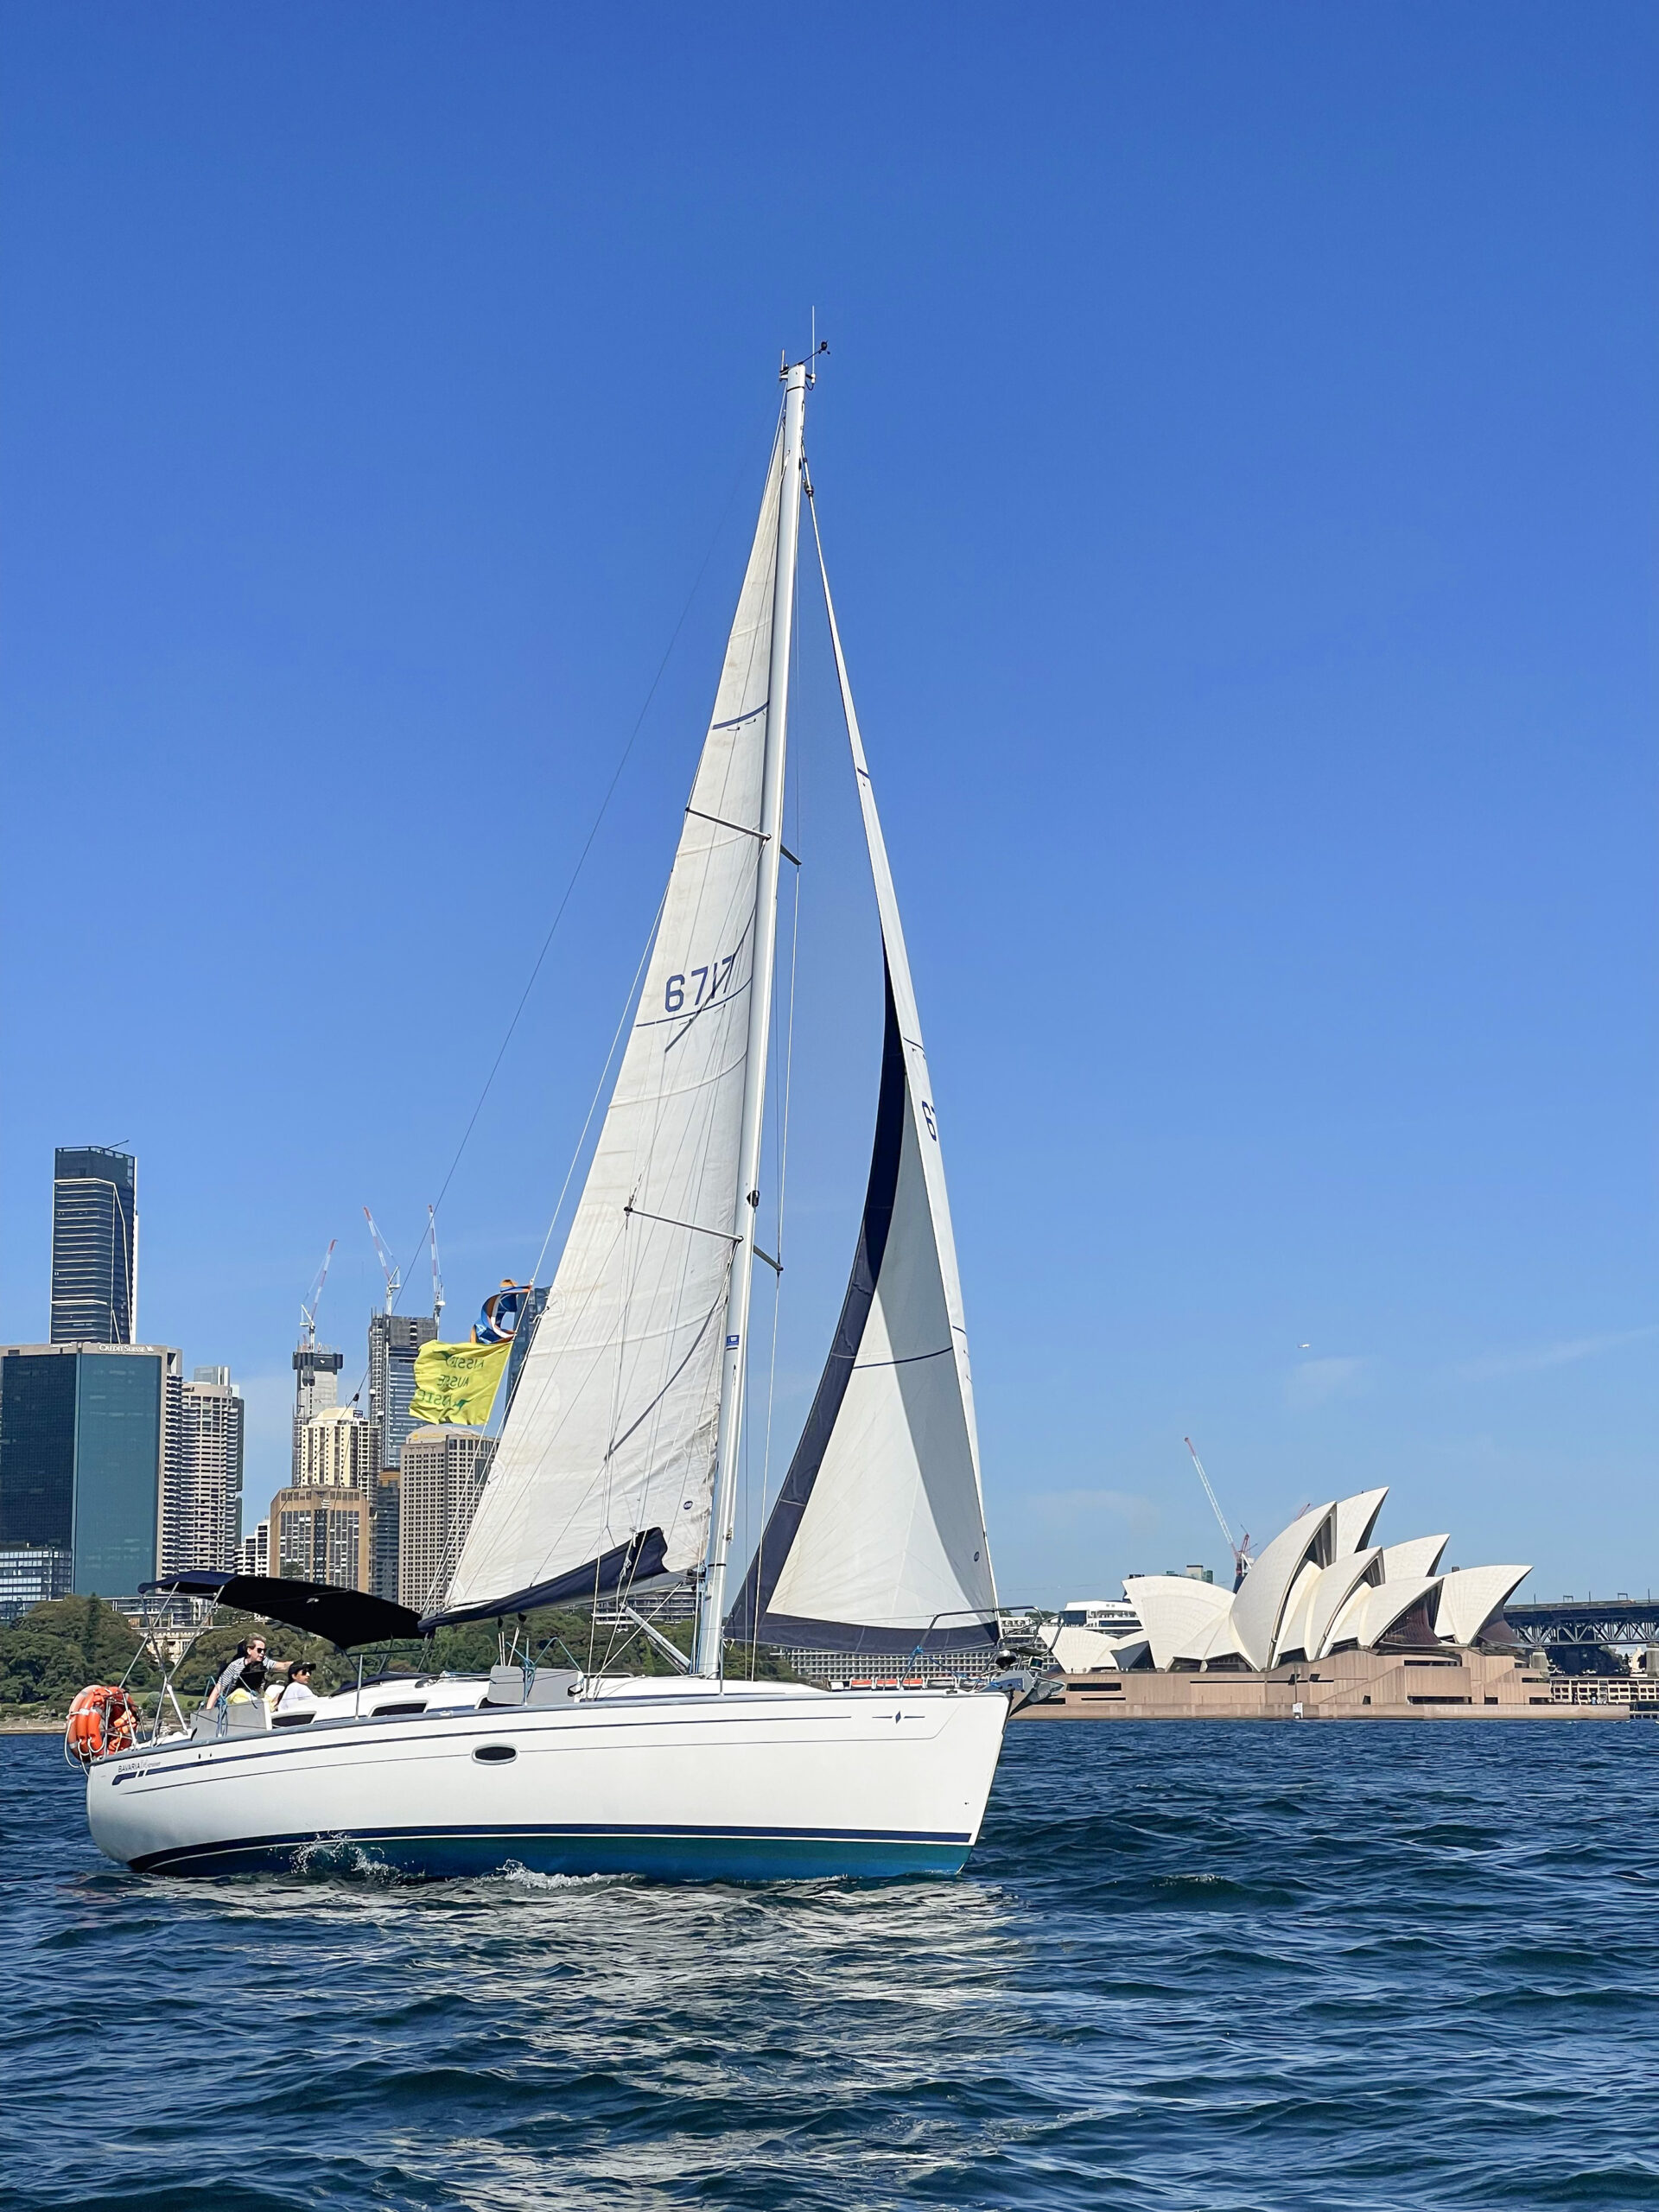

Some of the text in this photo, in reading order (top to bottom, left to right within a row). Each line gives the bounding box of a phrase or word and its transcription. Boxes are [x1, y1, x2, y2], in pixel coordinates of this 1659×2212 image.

[664, 955, 734, 1013] 6717
[99, 1344, 123, 1352] CREDIT
[118, 1762, 140, 1773] BAVARIA
